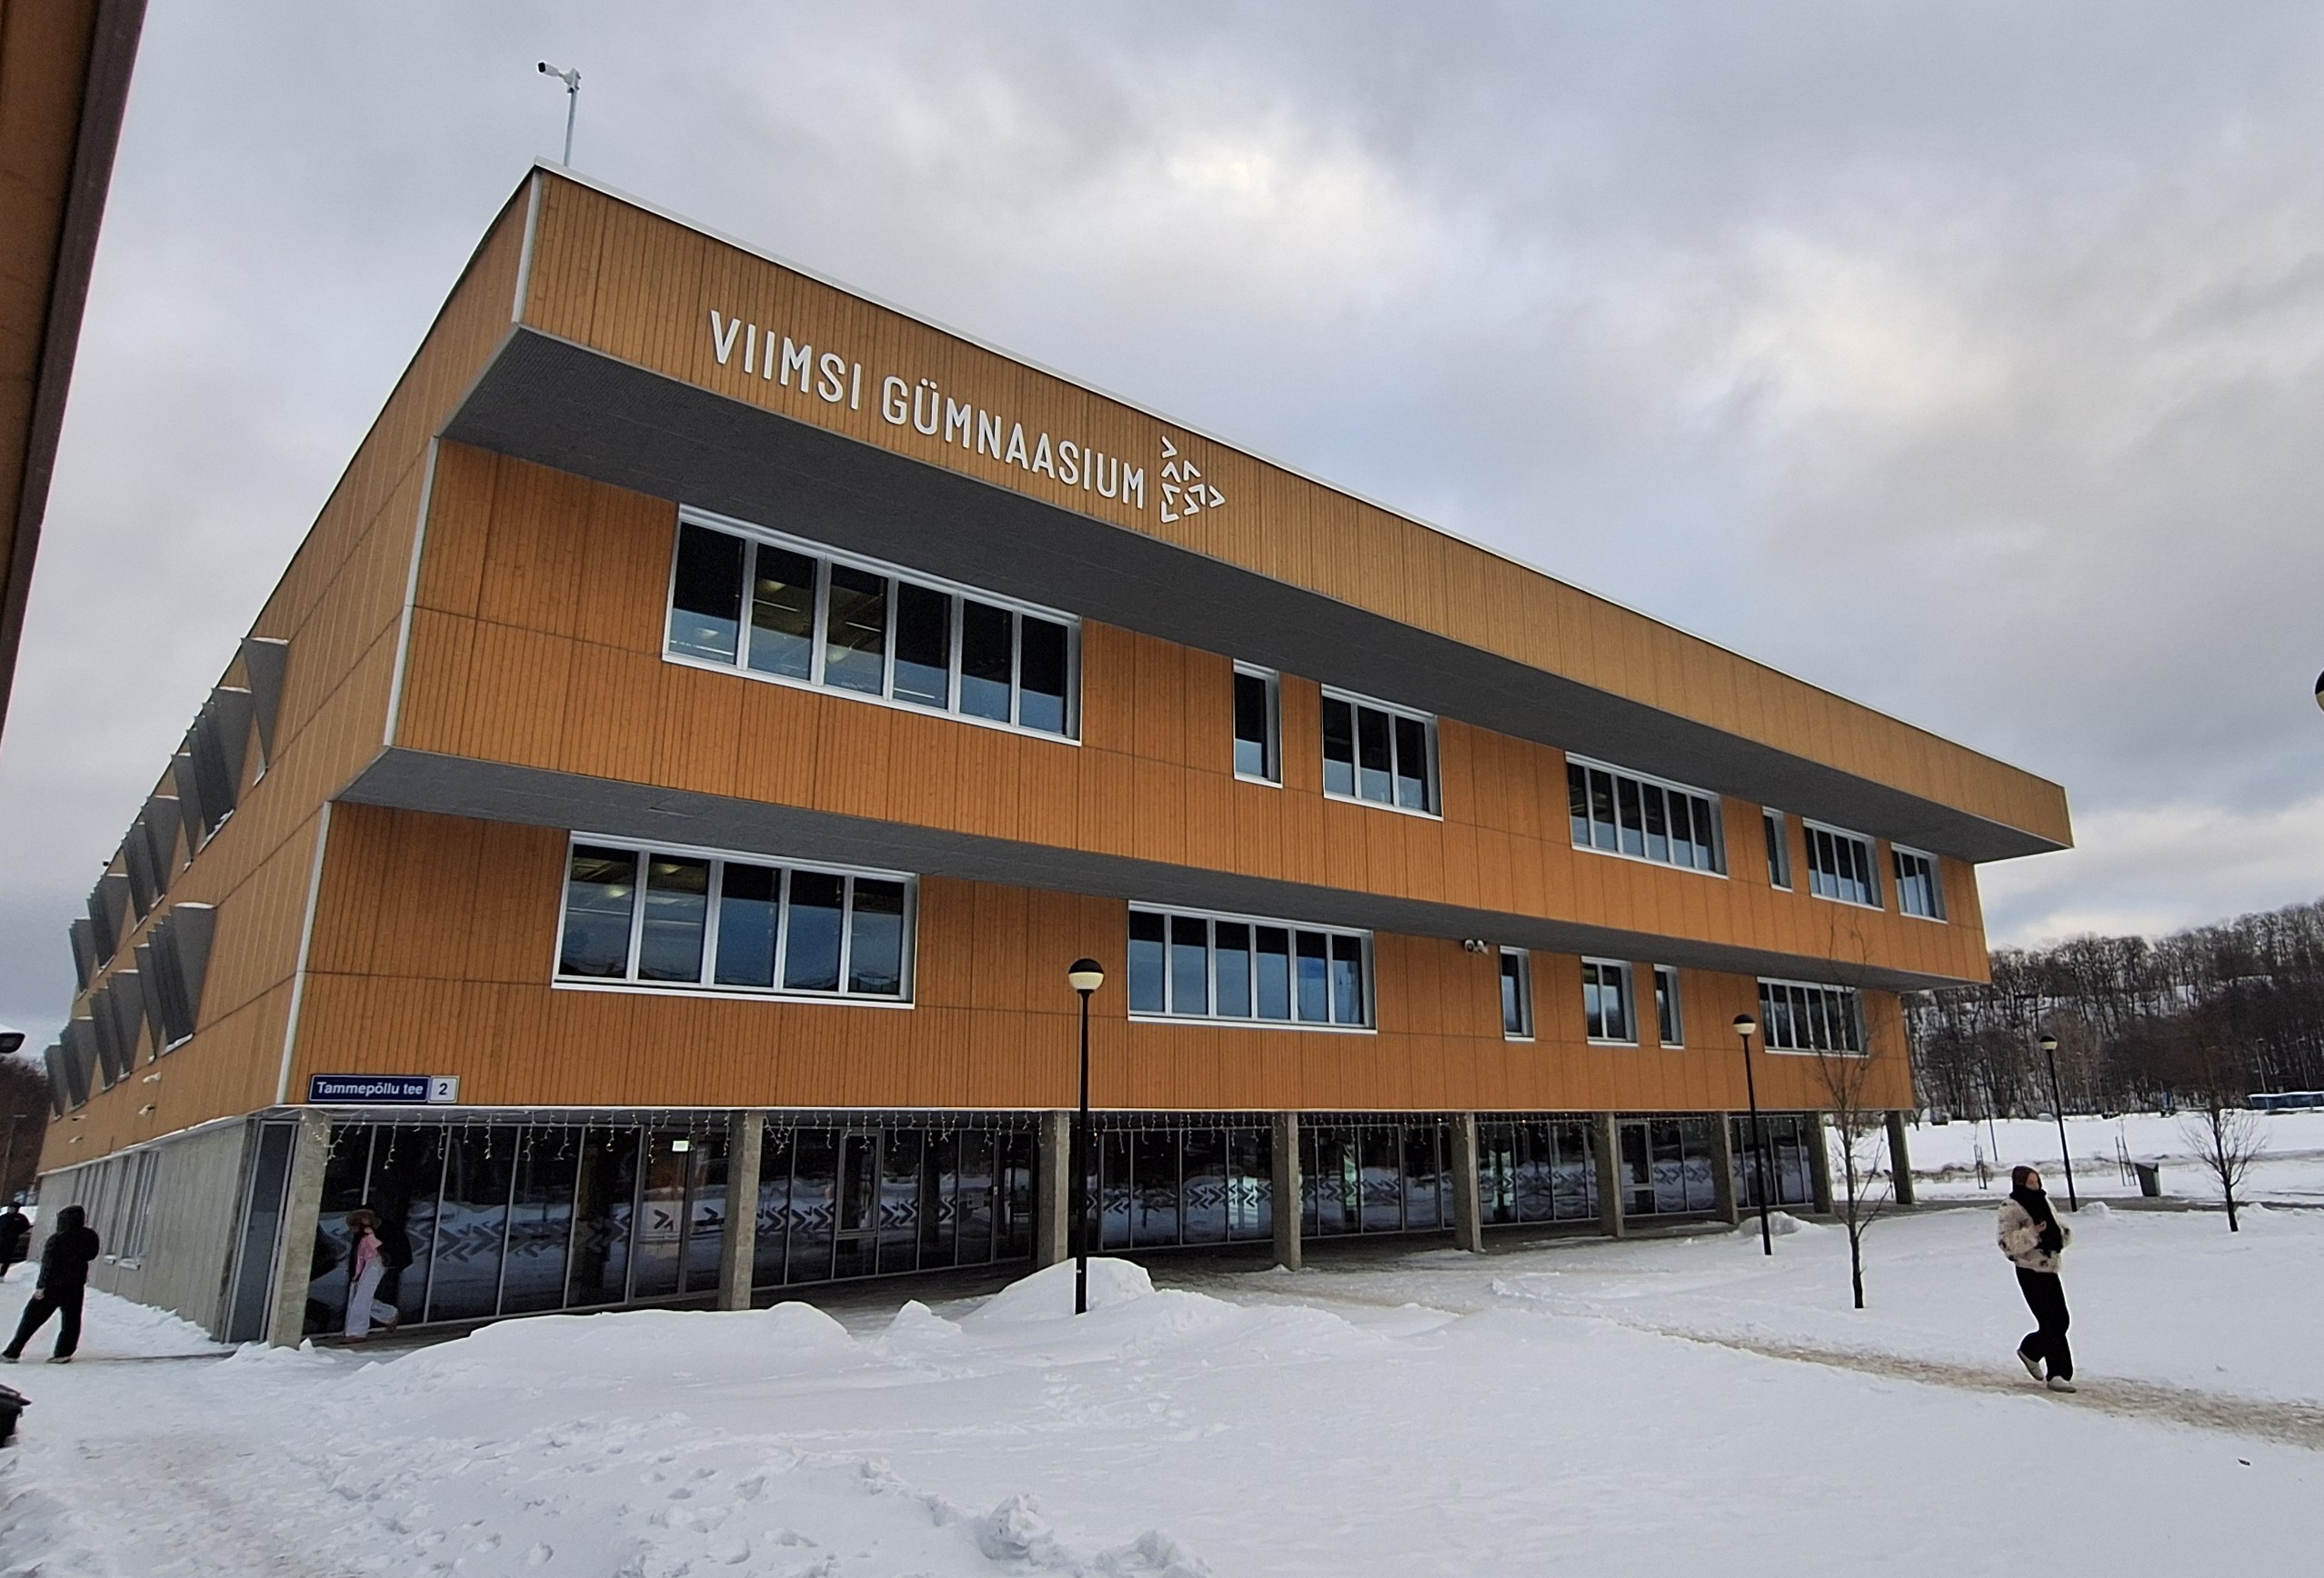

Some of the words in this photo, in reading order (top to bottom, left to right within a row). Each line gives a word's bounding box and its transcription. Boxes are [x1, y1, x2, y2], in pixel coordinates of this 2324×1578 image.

[710, 309, 862, 411] VIIMSI
[882, 375, 1145, 510] GÜMNAASIUM
[317, 1081, 400, 1096] Tammepõllu
[403, 1084, 424, 1095] tee
[438, 1083, 448, 1095] 2
